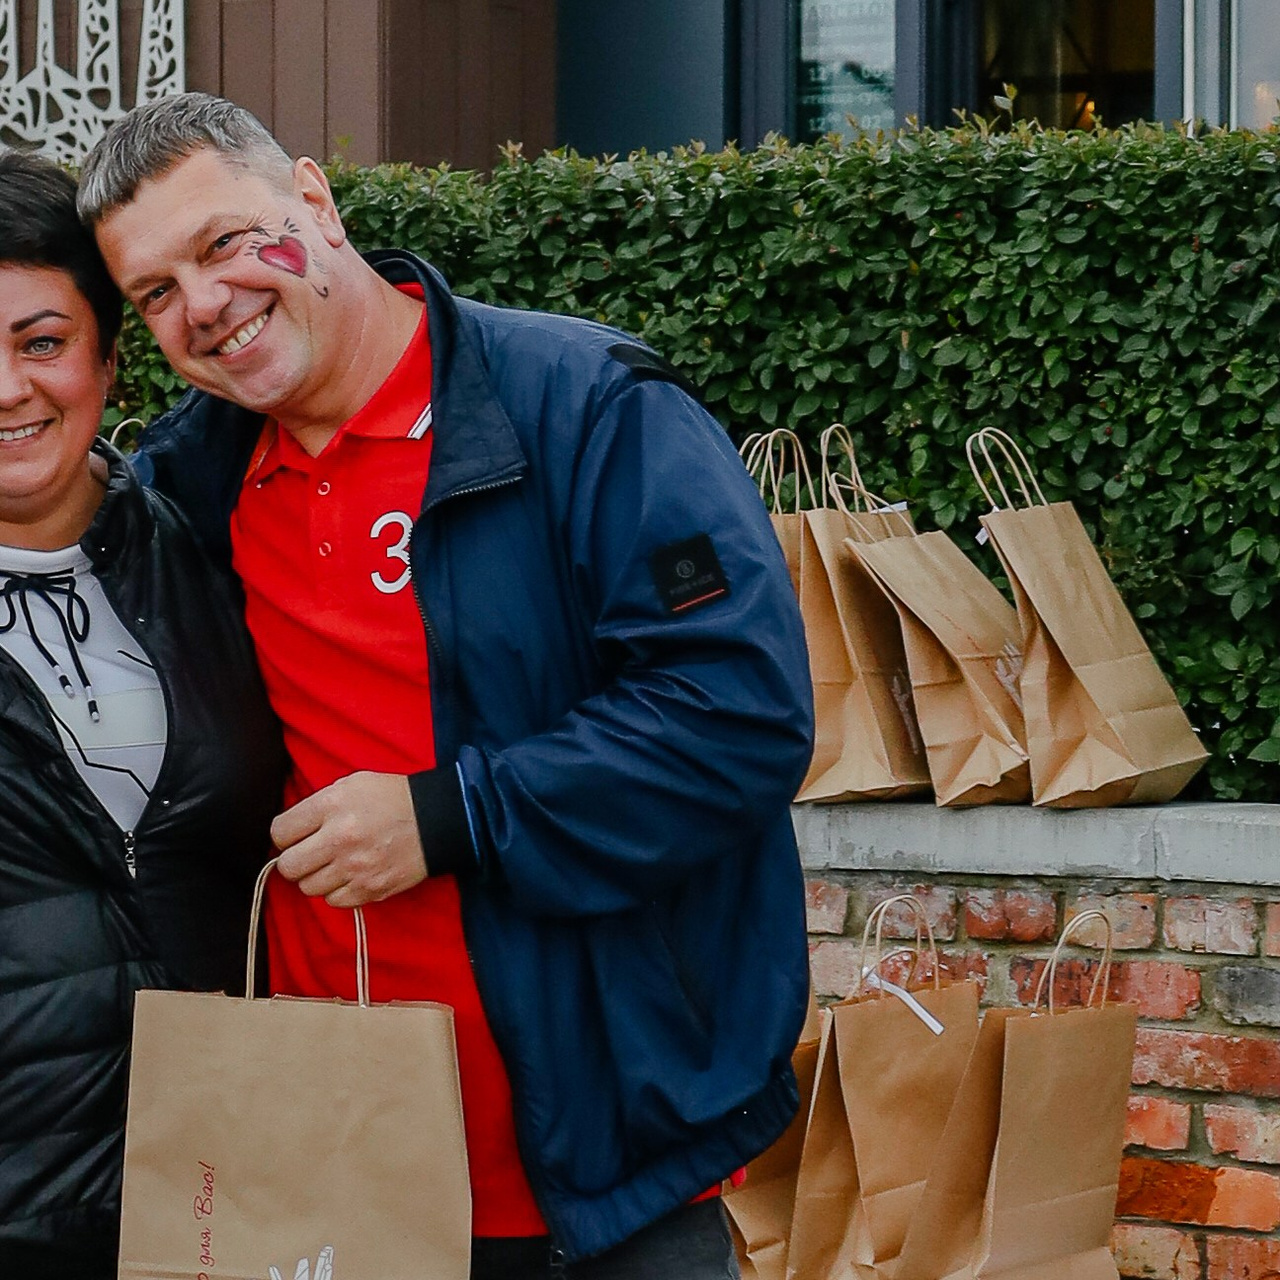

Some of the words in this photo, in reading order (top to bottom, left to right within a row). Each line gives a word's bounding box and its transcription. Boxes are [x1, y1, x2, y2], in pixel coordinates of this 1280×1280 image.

[370, 511, 413, 593] 3
[193, 1160, 215, 1220] Вас!
[199, 1227, 215, 1267] для
